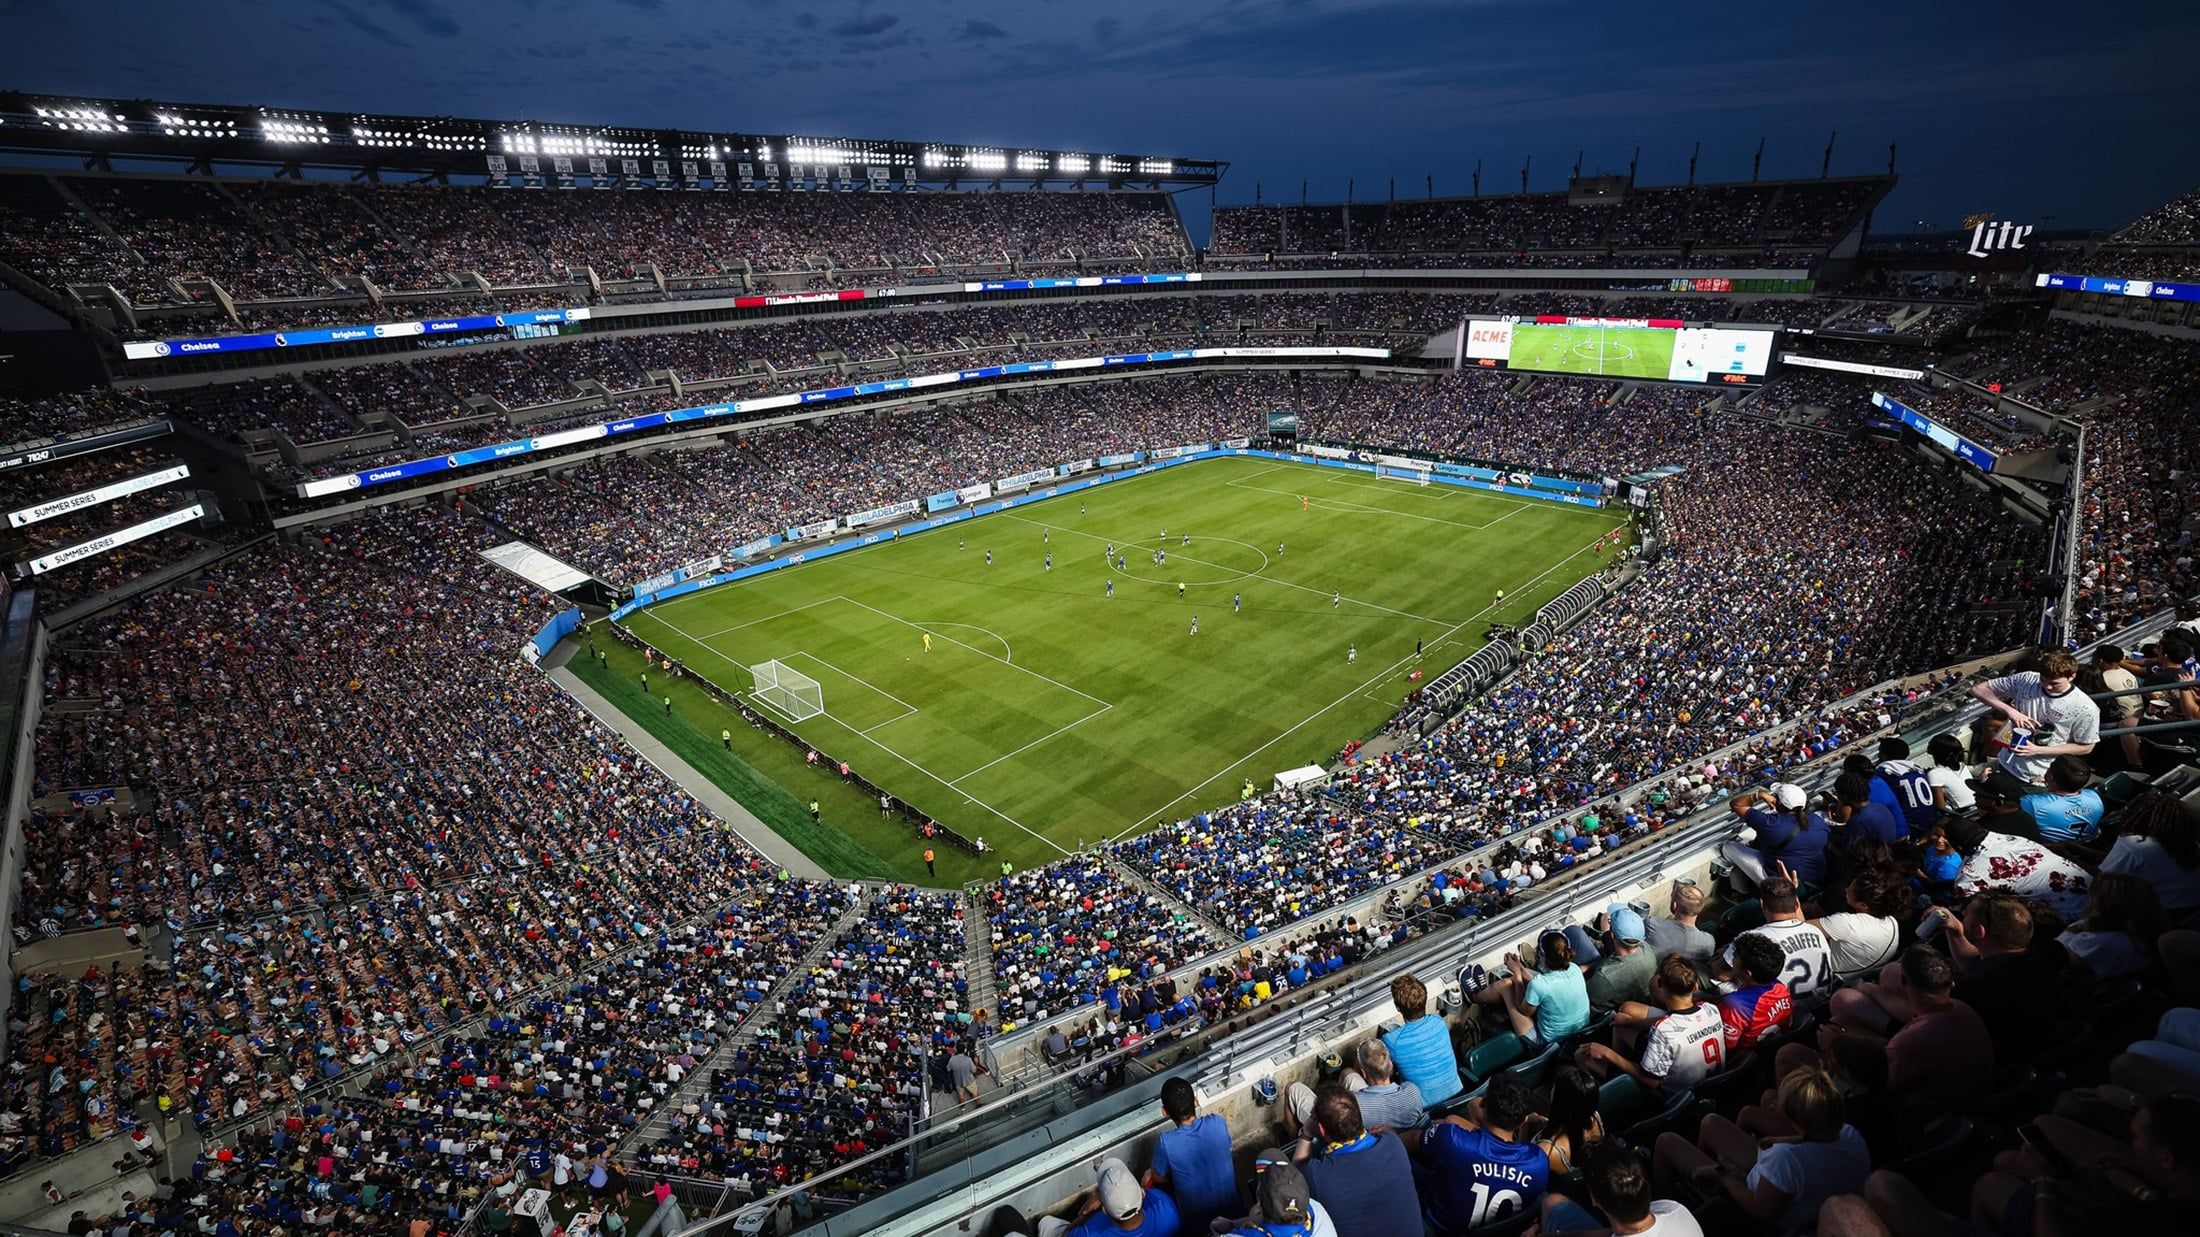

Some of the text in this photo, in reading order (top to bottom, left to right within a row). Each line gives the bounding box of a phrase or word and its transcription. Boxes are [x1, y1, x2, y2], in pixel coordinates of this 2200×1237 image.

[1967, 221, 2033, 258] Lite
[431, 321, 458, 331] Chelsea
[331, 329, 367, 341] Brighton
[1471, 330, 1508, 344] ACME
[180, 341, 221, 353] Chelsea
[612, 421, 635, 432] Chelsea
[494, 444, 525, 456] Brighton
[369, 469, 402, 482] Chelsea
[1438, 464, 1458, 473] League
[1000, 469, 1051, 488] PHILADELPHIA
[1489, 483, 1504, 491] FICO
[964, 490, 982, 499] League
[1563, 495, 1579, 504] FICO
[34, 501, 71, 518] SUMMER
[70, 494, 97, 508] SERIES
[850, 501, 915, 524] PHILADELPHIA
[864, 534, 879, 545] FICO
[54, 544, 90, 564] SUMMER
[90, 537, 115, 551] SERIES
[699, 578, 716, 588] FICO
[1900, 777, 1934, 808] 10
[2064, 807, 2092, 818] MYERS
[1780, 932, 1822, 955] GRIFFEY
[1785, 952, 1833, 999] 24
[1767, 999, 1791, 1022] JAMES
[1686, 1021, 1723, 1045] LEWANDOWSK
[1701, 1037, 1722, 1077] 9
[1472, 1163, 1532, 1187] PULISIC
[1467, 1182, 1523, 1229] 10
